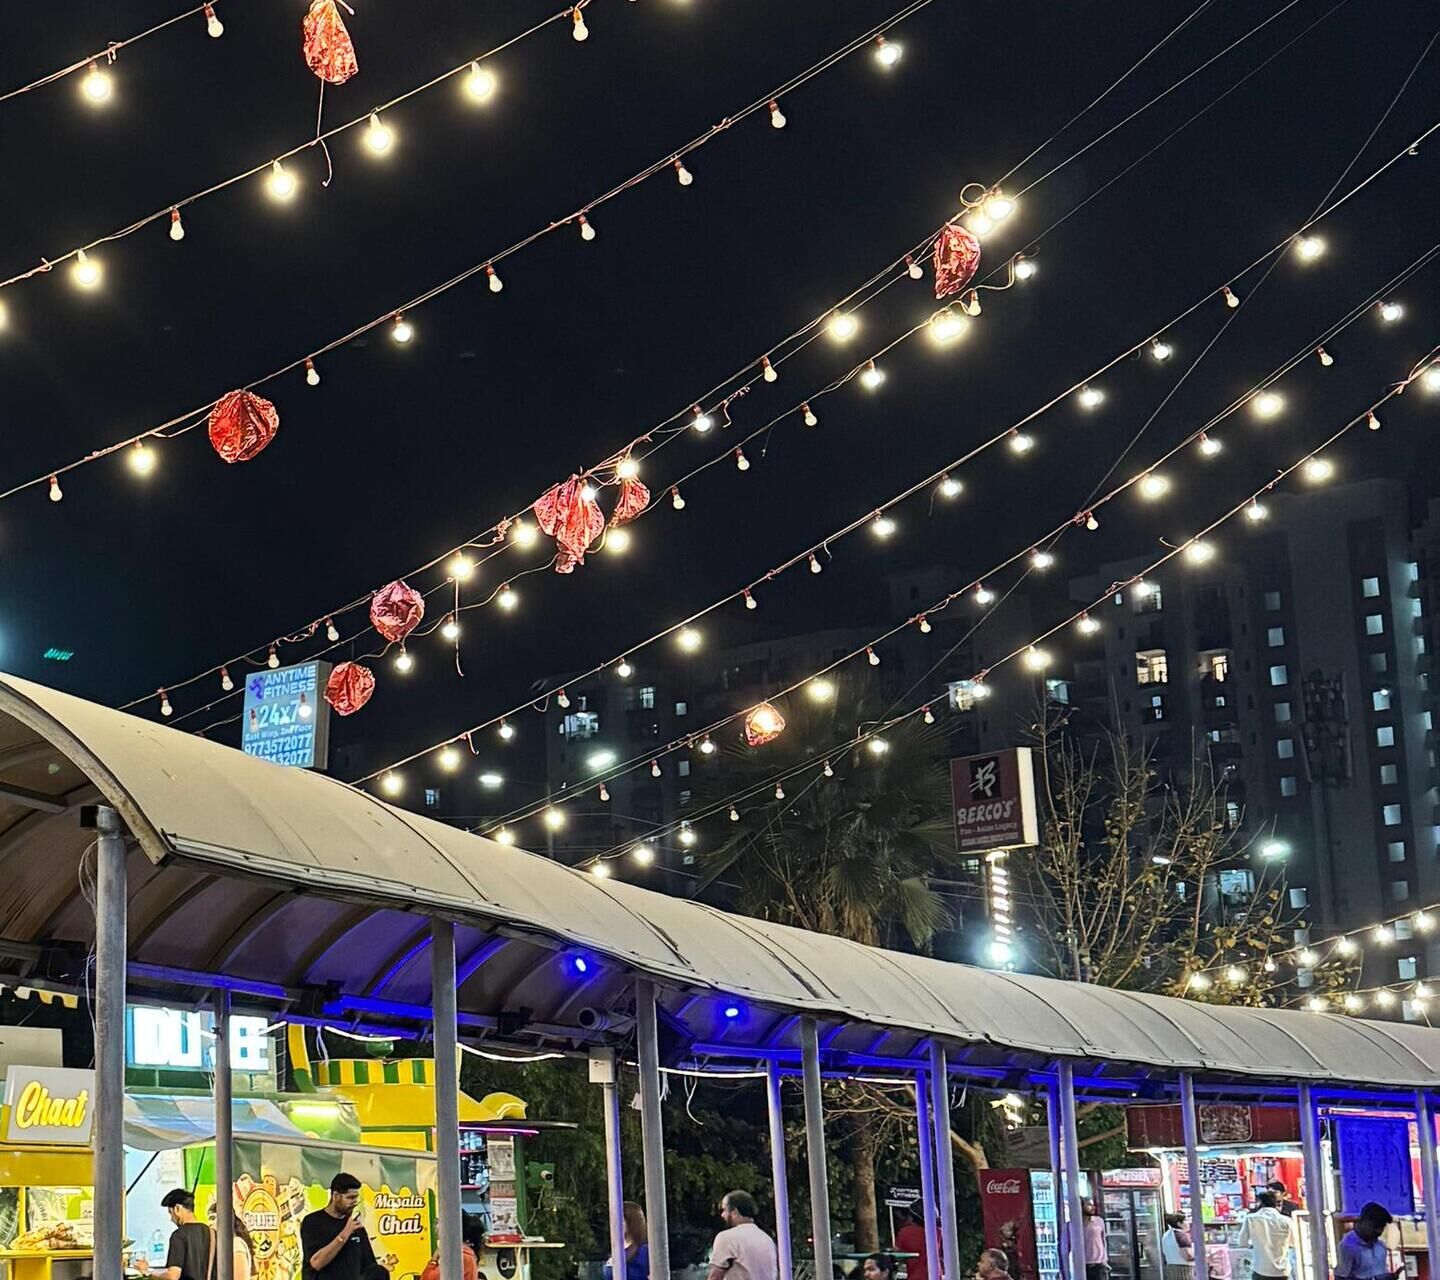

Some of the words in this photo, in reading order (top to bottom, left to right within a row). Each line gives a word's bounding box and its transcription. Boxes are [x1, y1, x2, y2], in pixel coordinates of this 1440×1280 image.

[265, 665, 316, 685] ANYTIME
[263, 678, 315, 699] FITNESS
[957, 800, 1013, 825] BERCO'S
[16, 1081, 88, 1129] Chaat
[374, 1194, 425, 1208] Masala
[379, 1213, 423, 1235] Chai
